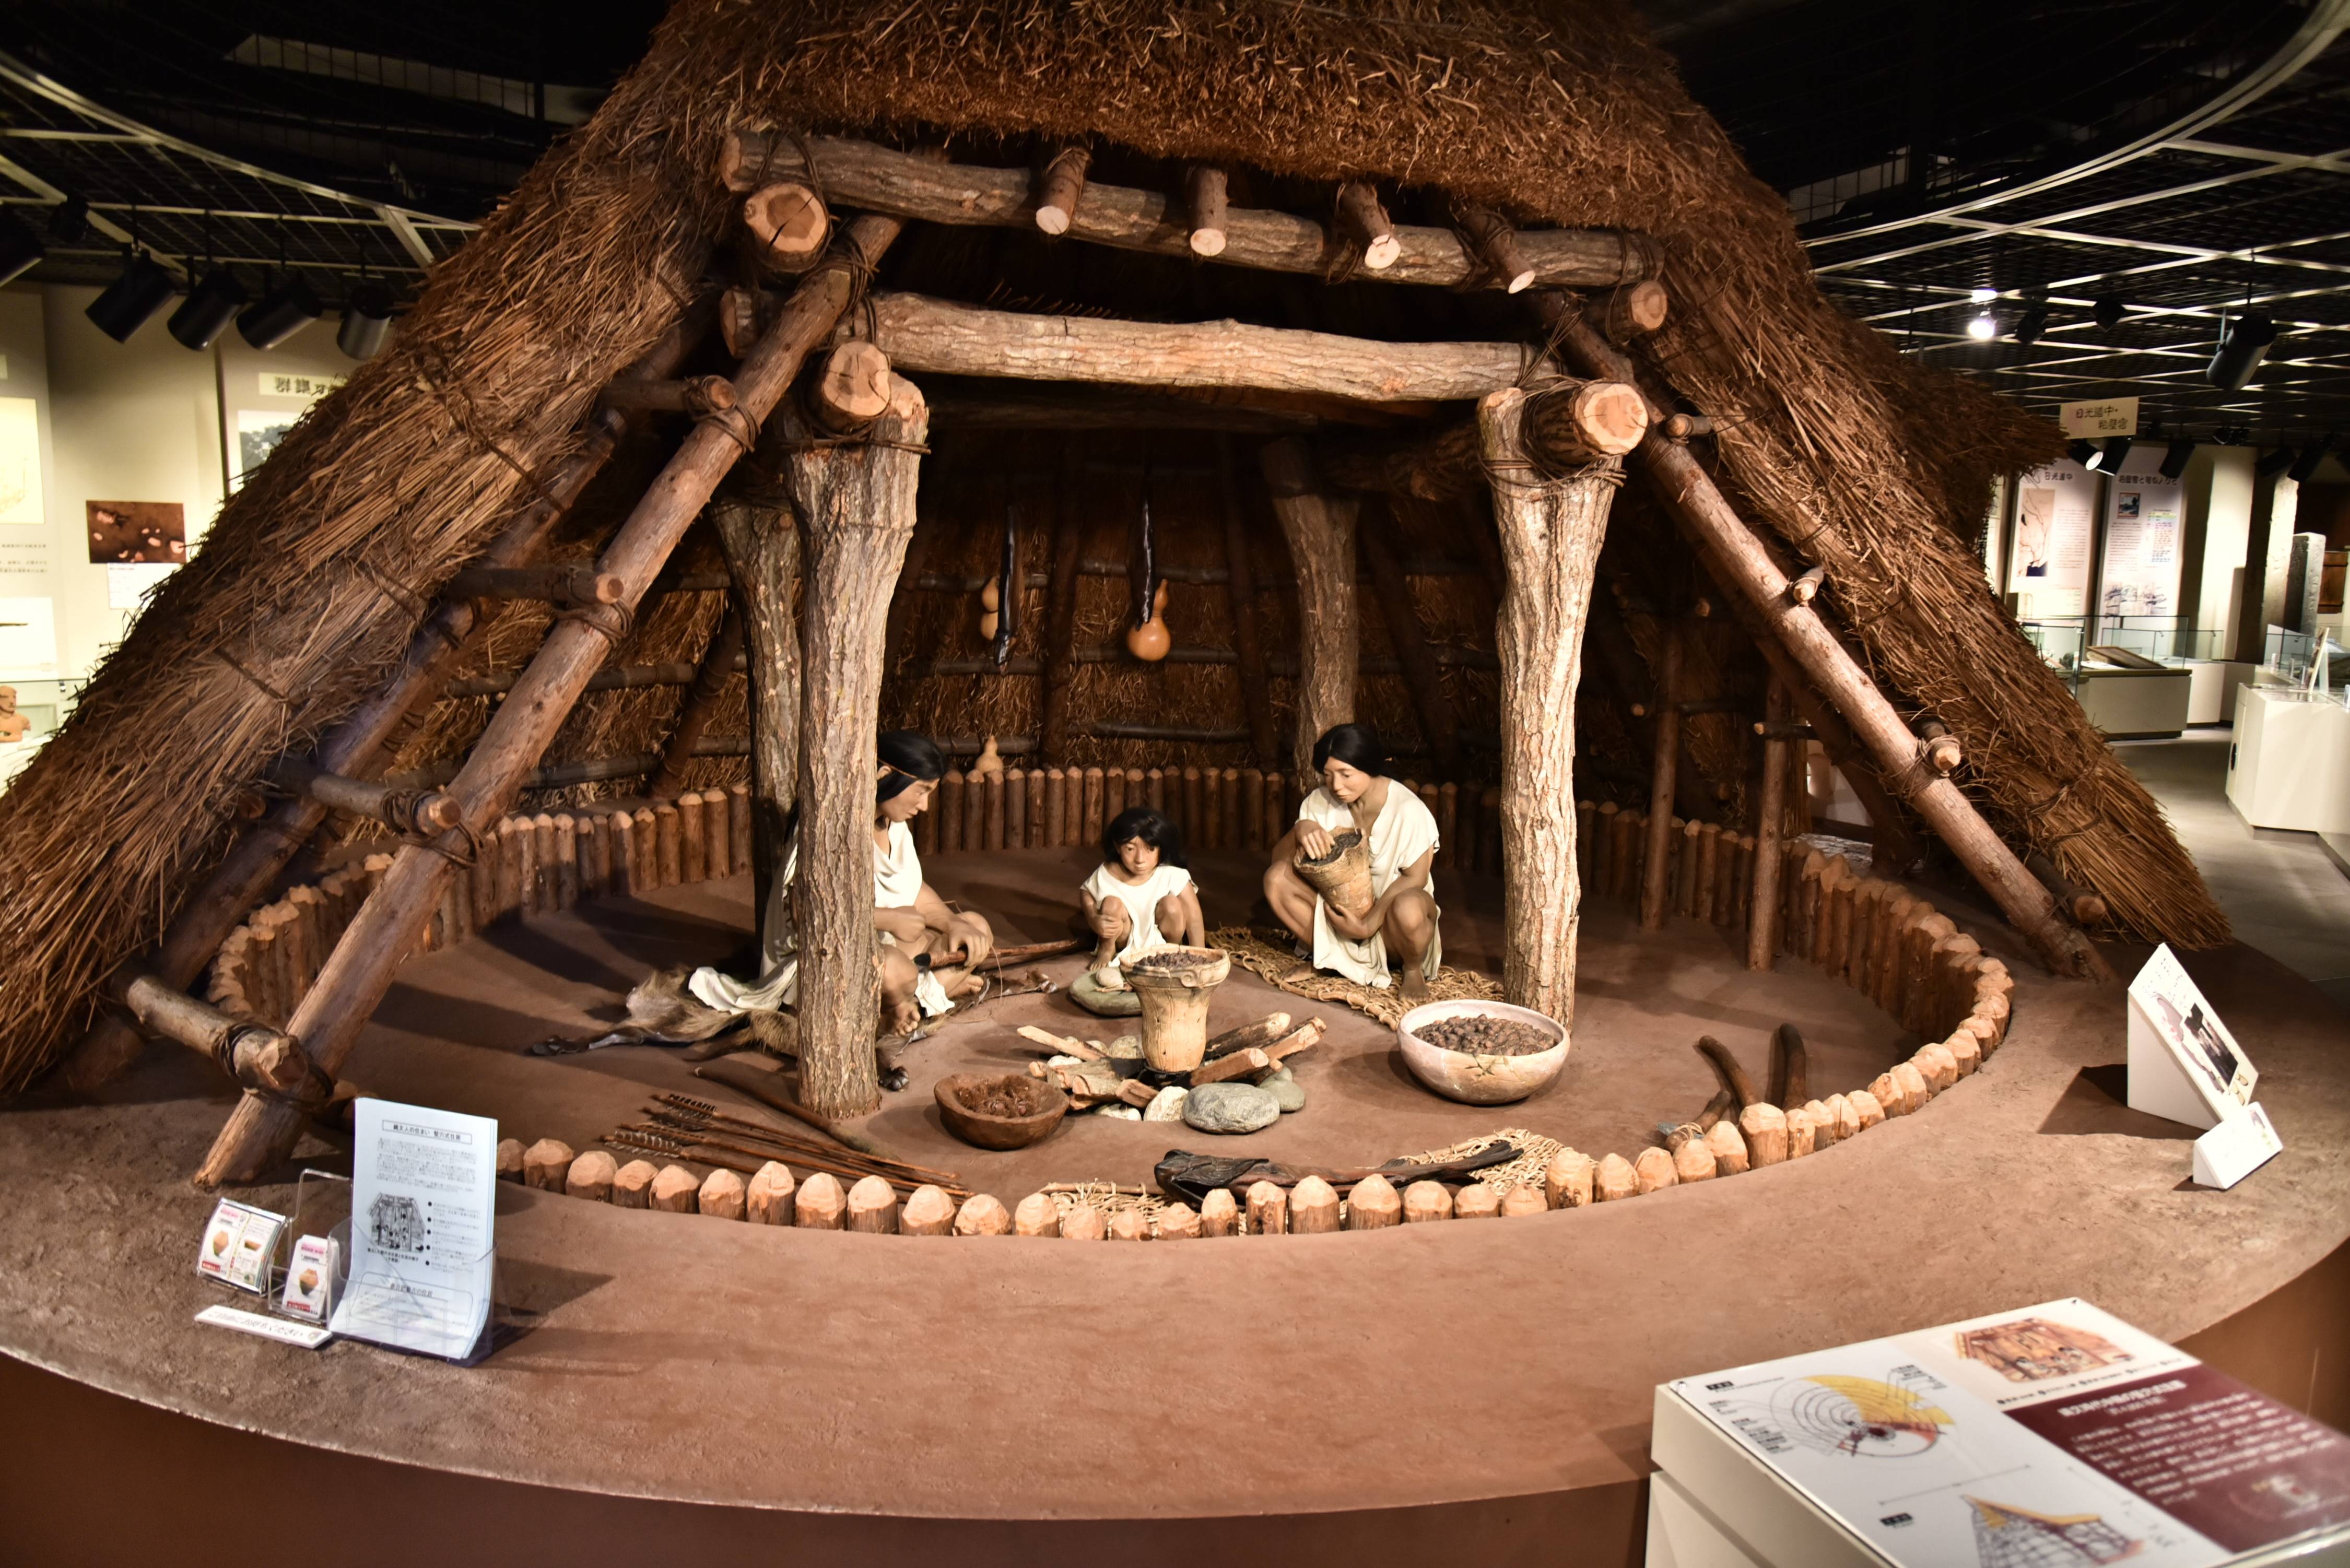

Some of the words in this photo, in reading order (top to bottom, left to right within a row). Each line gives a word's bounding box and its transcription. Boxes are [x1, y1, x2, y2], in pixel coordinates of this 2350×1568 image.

[2045, 471, 2073, 481] 日光道中
[393, 1124, 430, 1136] 縄文人の住まい
[433, 1130, 461, 1141] 竪穴式住居
